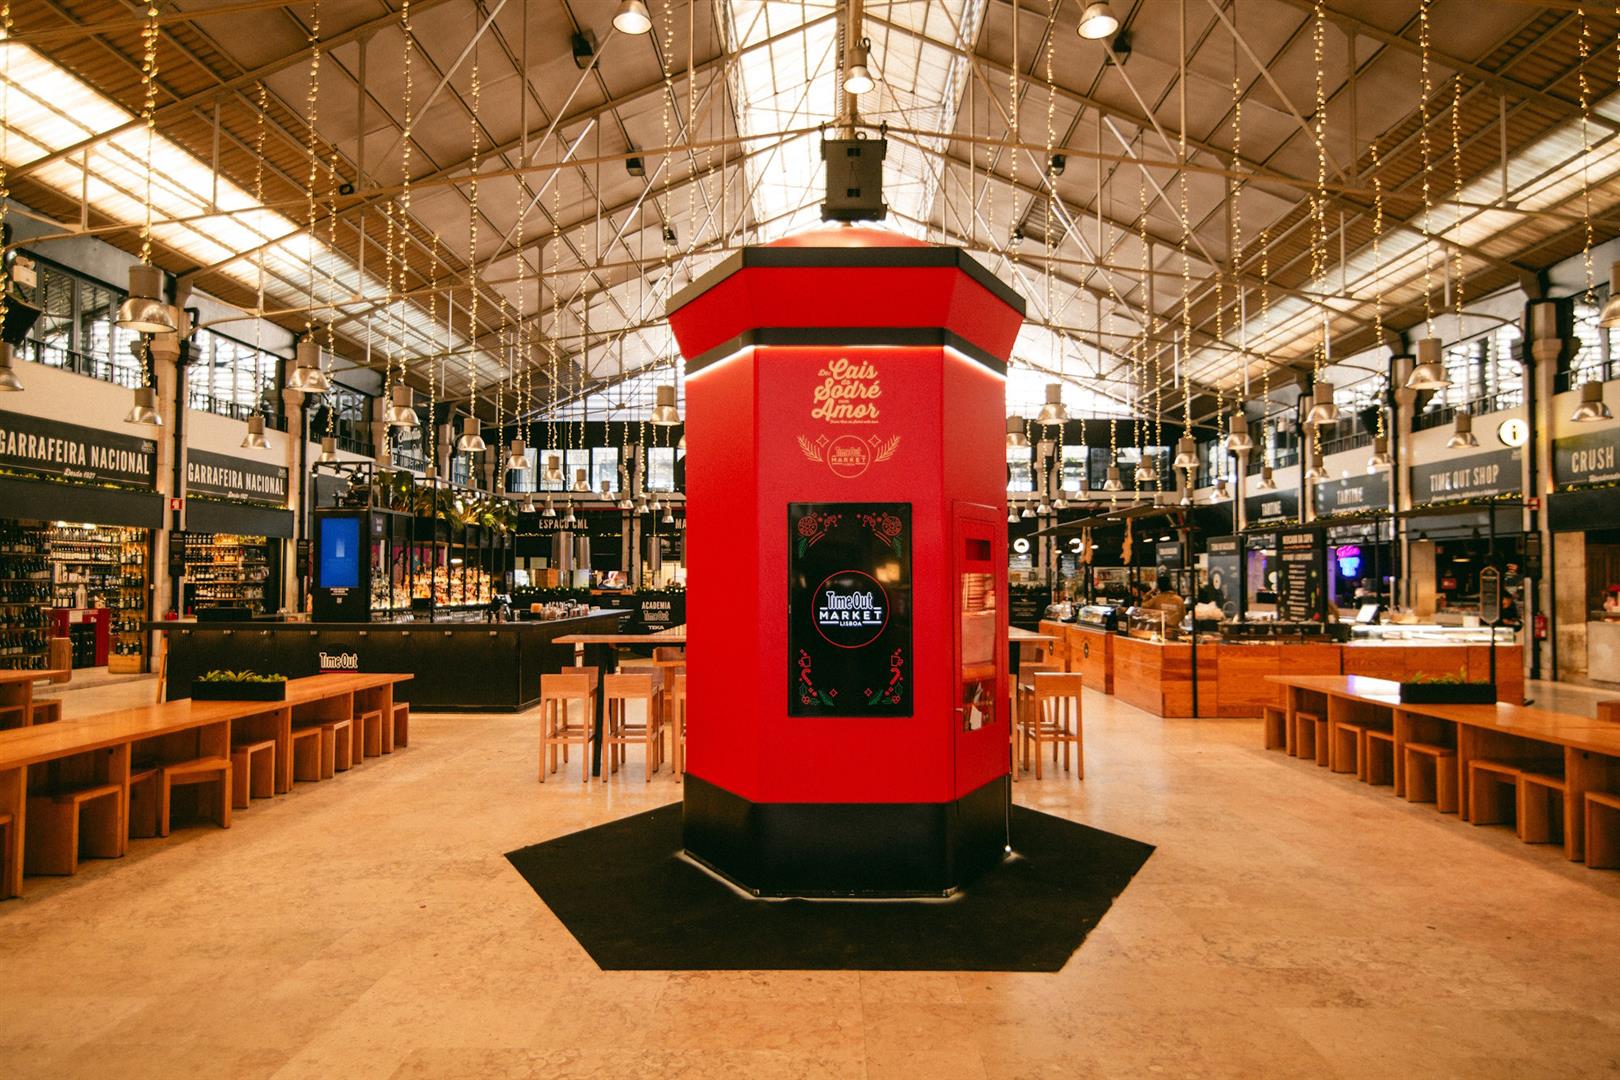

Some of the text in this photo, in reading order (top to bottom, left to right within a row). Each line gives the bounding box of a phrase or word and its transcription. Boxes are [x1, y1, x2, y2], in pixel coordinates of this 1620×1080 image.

[829, 358, 878, 380] Cais
[813, 377, 882, 404] Sodré
[811, 398, 880, 421] Amor
[0, 429, 150, 475] GARRAFEIRA NACIONAL
[1571, 446, 1615, 474] CRUSH
[187, 462, 285, 496] GARRAFEIRA NACIONAL
[1429, 464, 1499, 492] TIME OUT SHOP
[640, 601, 671, 610] ACADEMIA
[819, 610, 882, 620] MARKET
